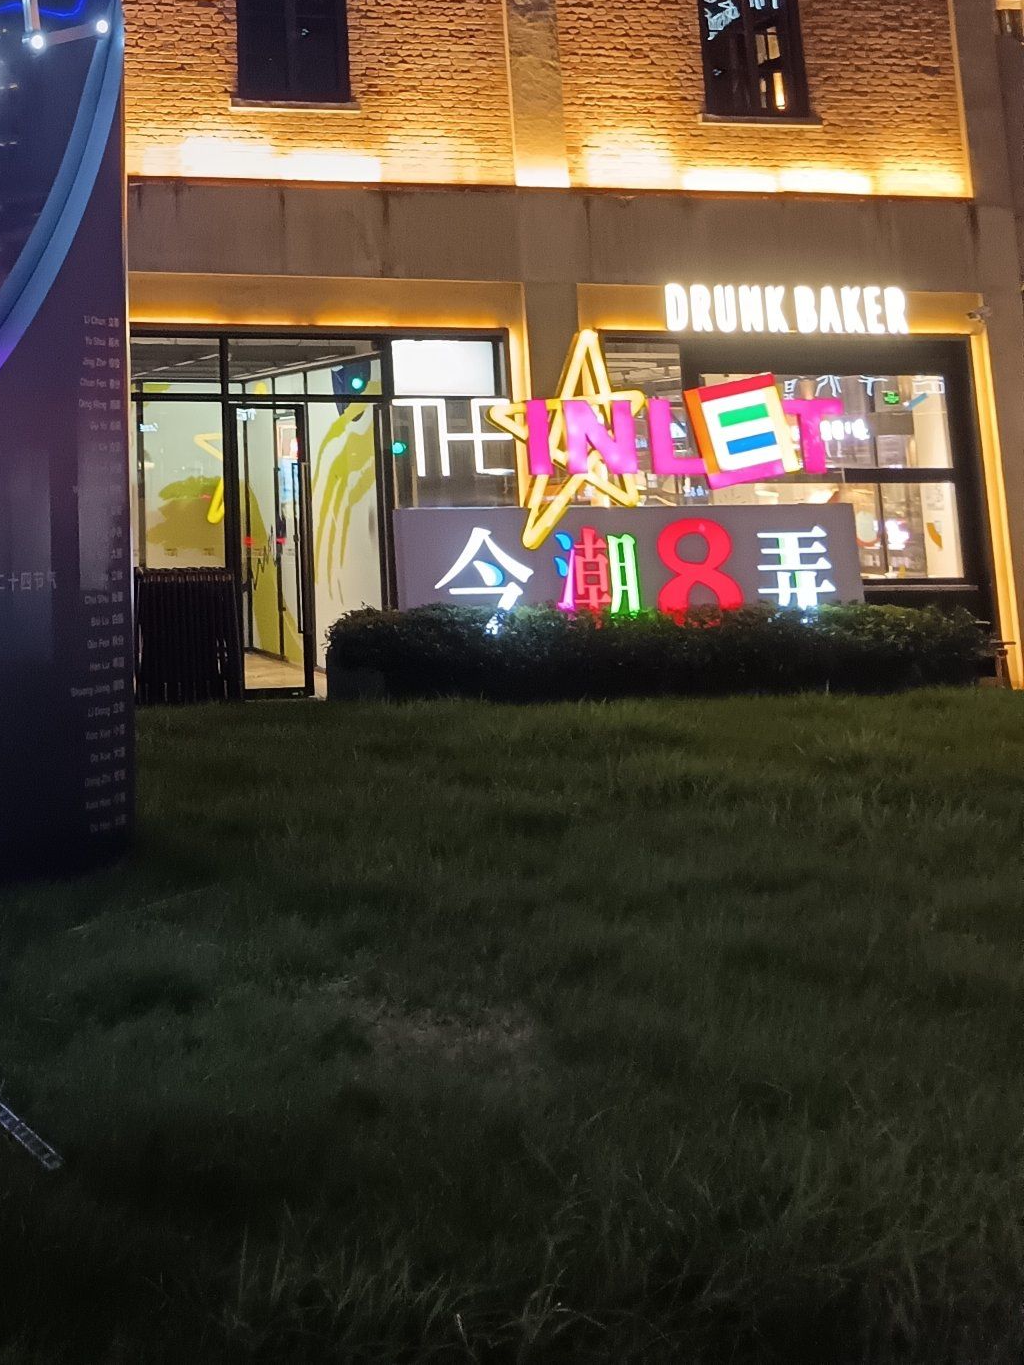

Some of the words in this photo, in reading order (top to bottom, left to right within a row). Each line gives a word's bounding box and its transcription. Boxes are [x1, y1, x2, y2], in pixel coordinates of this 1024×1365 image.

[664, 282, 789, 333] DRUNK
[793, 285, 909, 334] BAKER
[391, 397, 515, 477] THE
[526, 371, 844, 490] INLET
